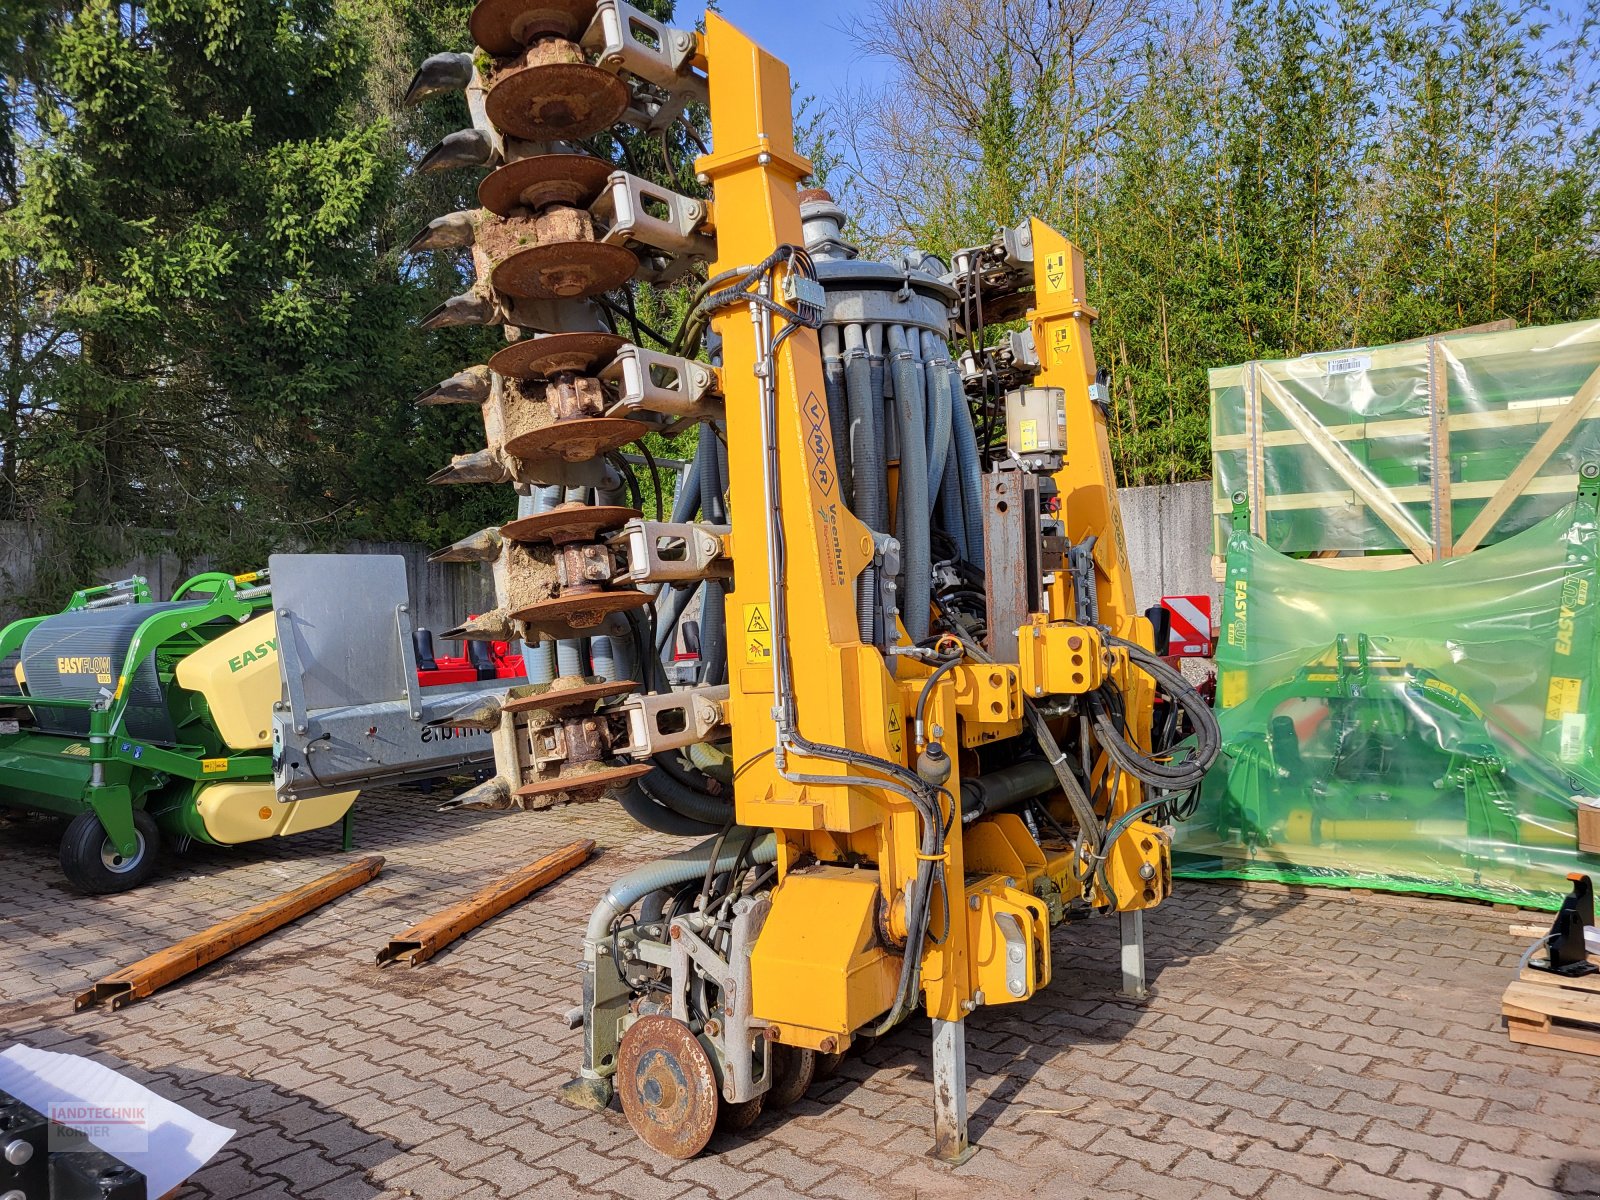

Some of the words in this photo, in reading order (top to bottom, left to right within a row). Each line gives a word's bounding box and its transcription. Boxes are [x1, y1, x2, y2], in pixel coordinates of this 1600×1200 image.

[829, 503, 846, 586] Veenhuis
[1234, 580, 1247, 651] EASYCUT
[1555, 571, 1579, 656] EASYCUT
[58, 656, 111, 674] EASYFLOW
[228, 638, 278, 673] EASY
